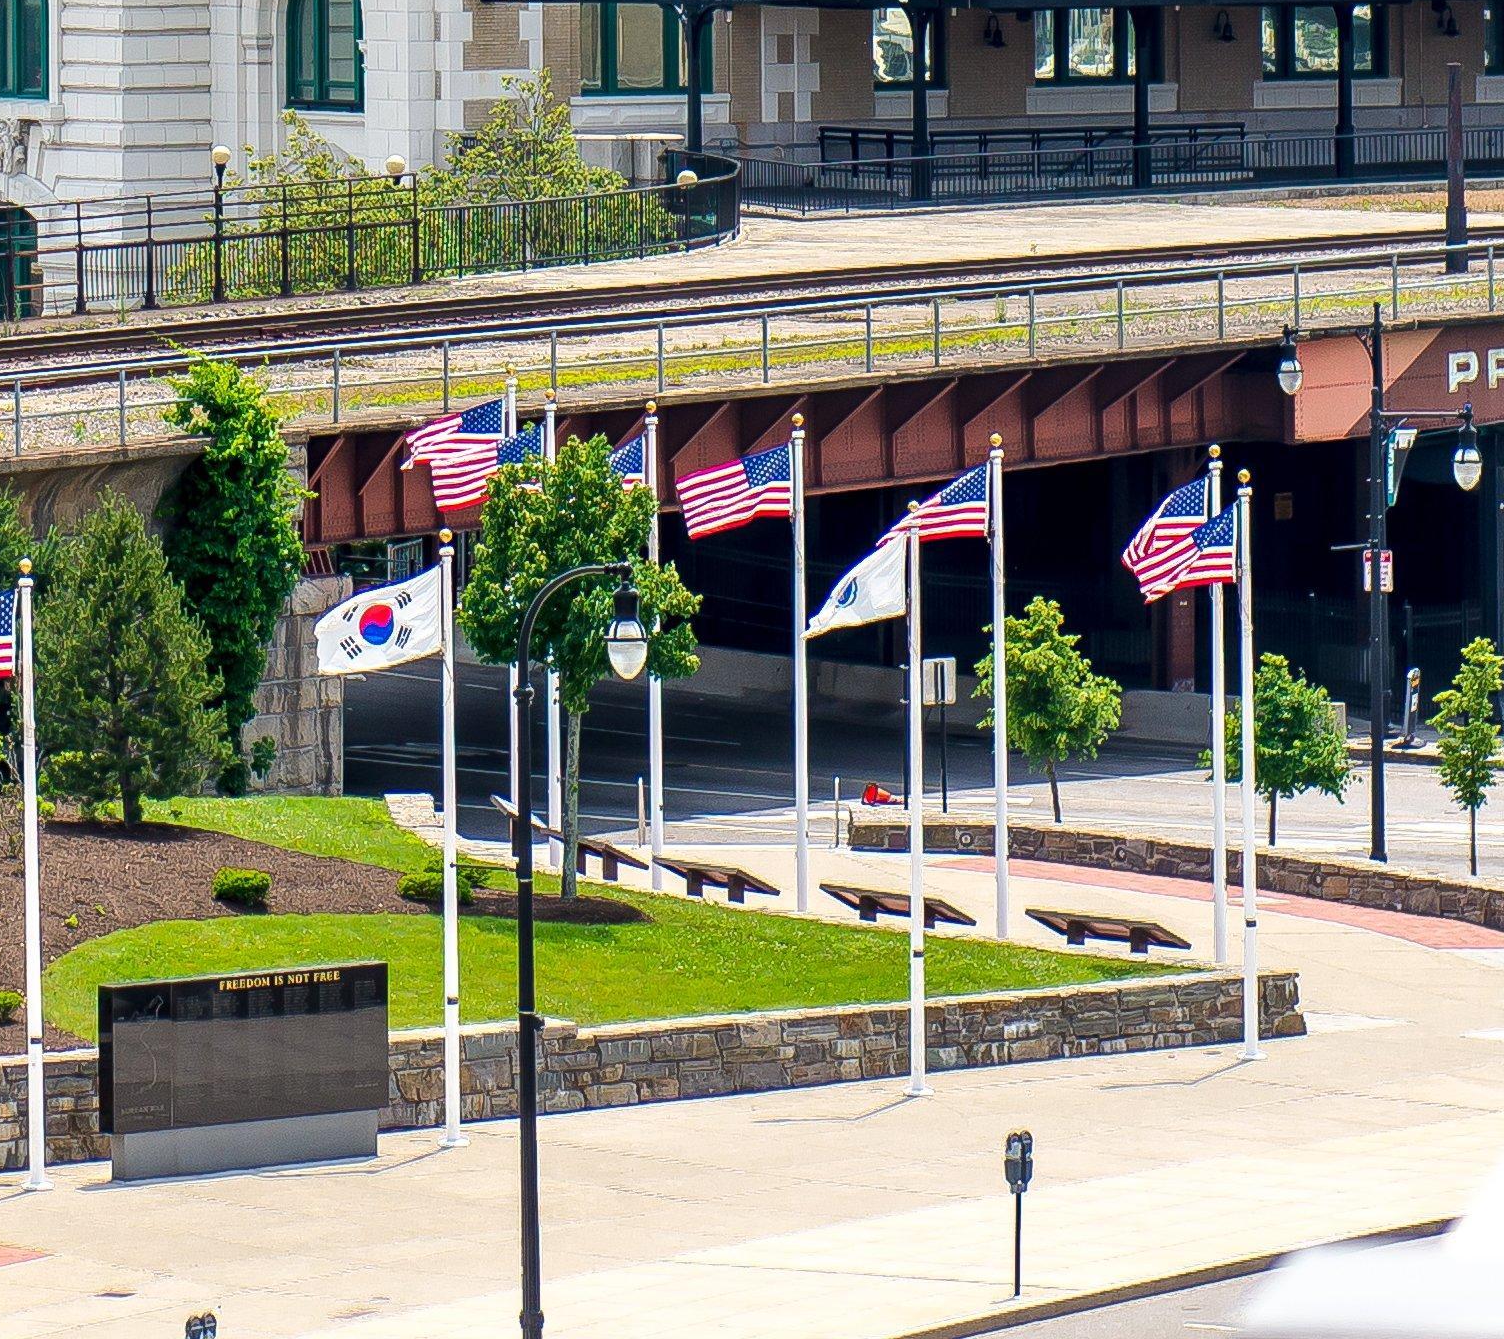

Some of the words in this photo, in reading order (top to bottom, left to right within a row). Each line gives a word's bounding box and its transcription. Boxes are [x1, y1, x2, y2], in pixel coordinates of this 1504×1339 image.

[219, 976, 270, 991] FREEDOM
[274, 975, 284, 985] IS
[287, 973, 310, 985] NOT
[313, 970, 340, 982] FREE
